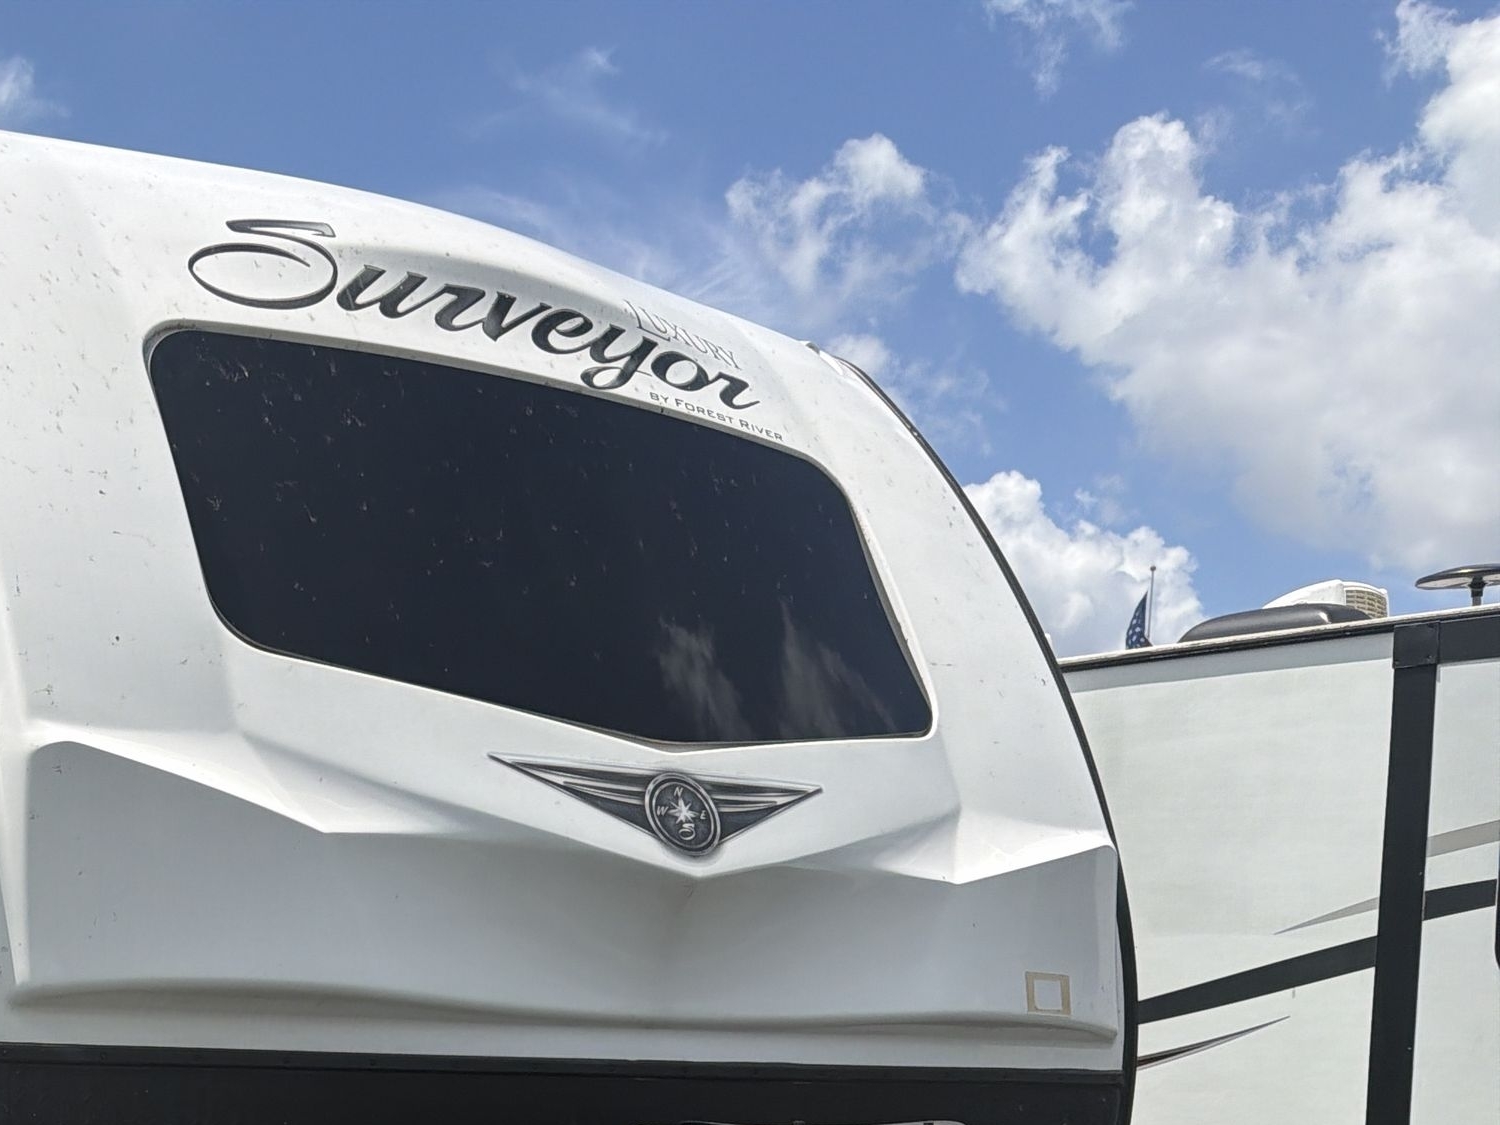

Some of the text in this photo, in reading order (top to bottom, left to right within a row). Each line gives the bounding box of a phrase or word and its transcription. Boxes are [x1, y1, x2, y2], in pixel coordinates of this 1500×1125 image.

[188, 218, 761, 410] Surveyor
[624, 299, 742, 371] LUXURY
[650, 391, 784, 442] BY FOREST RIVER
